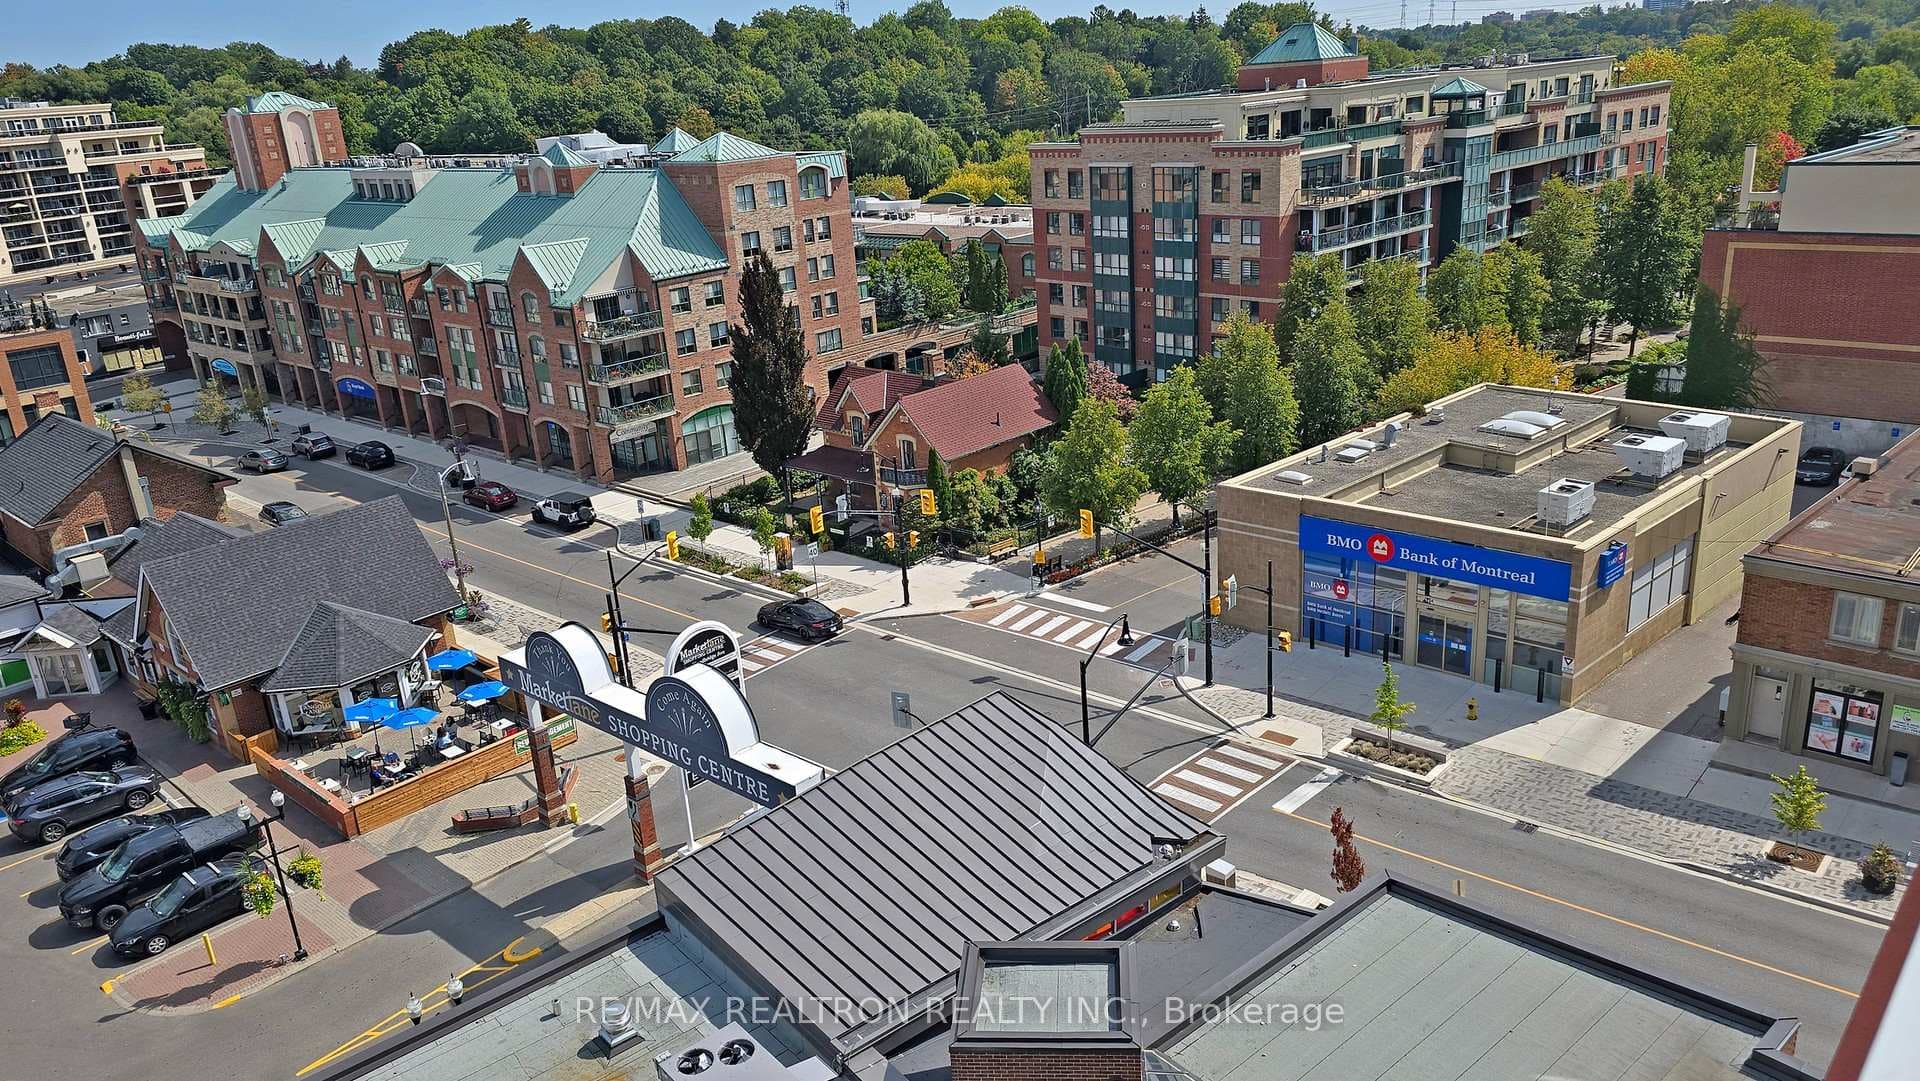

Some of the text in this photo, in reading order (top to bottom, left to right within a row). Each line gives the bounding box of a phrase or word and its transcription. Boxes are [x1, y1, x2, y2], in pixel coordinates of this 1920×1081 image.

[1327, 534, 1362, 550] BMO
[1400, 547, 1535, 585] Bank of Montreal
[1310, 581, 1330, 590] BMO
[533, 642, 571, 671] Thank You
[656, 691, 712, 729] Come Again
[608, 715, 692, 766] SHOPPING
[698, 756, 770, 802] CENTRE
